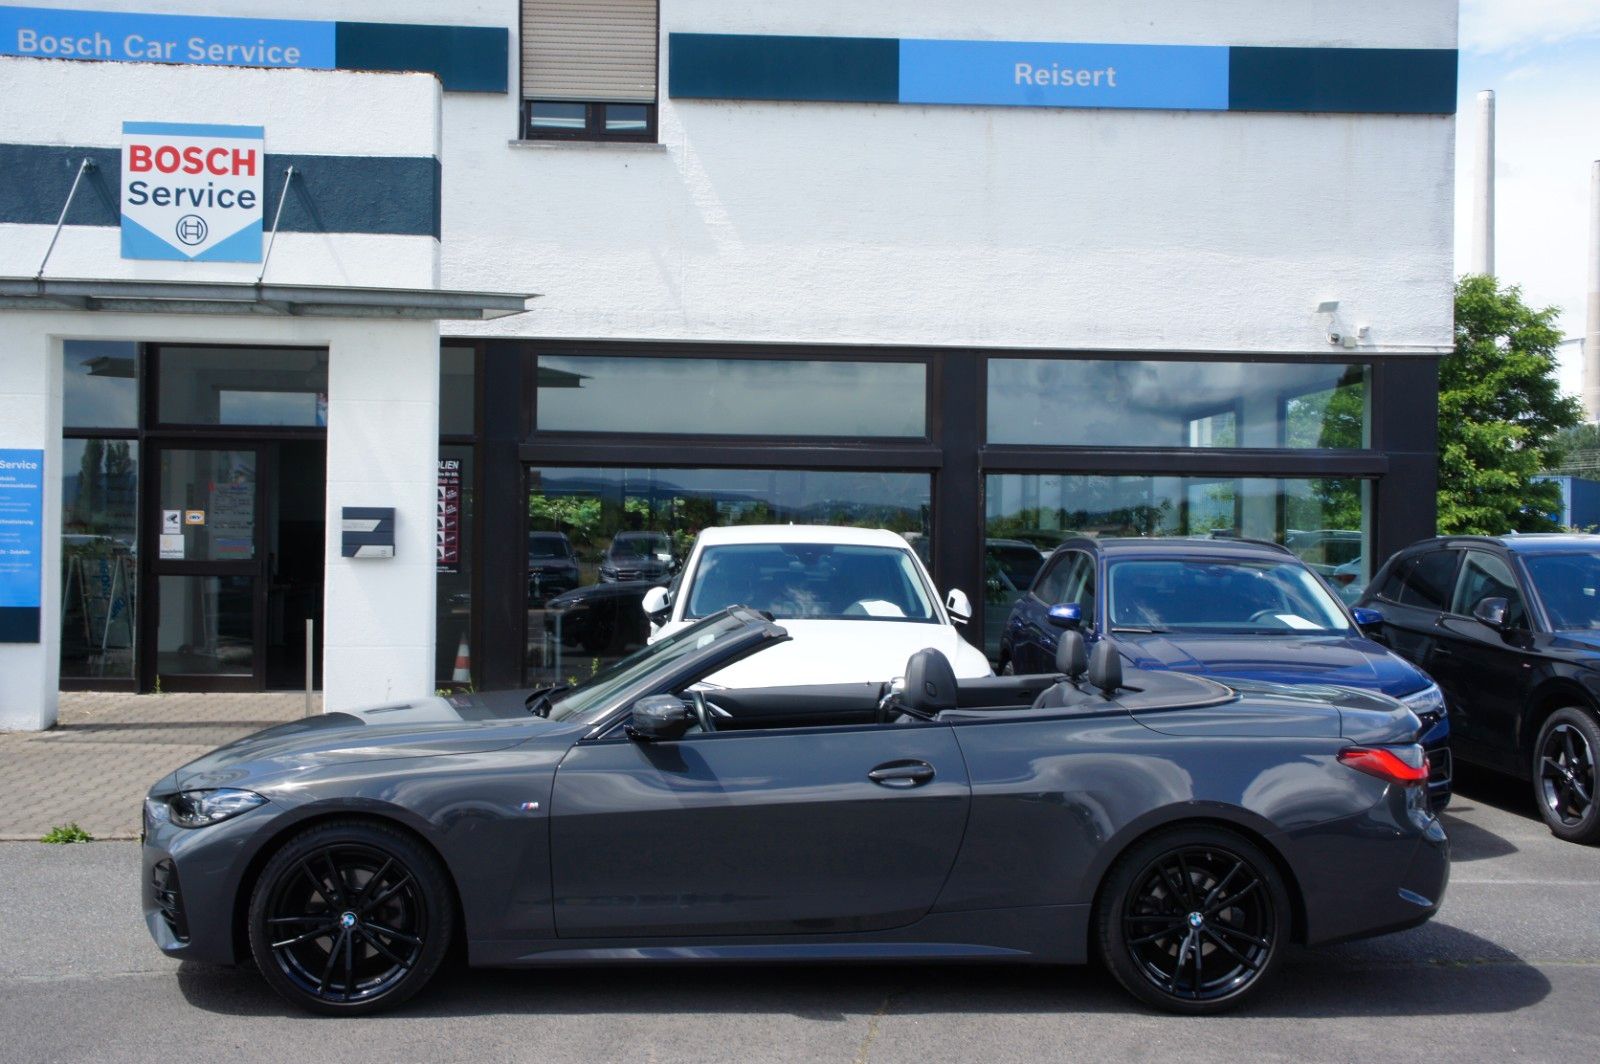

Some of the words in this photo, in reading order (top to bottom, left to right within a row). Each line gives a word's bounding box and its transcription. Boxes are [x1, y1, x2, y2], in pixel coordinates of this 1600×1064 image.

[17, 29, 111, 56] Bosch
[123, 34, 177, 59] Car
[187, 37, 300, 64] Service
[1014, 62, 1118, 88] Reisert
[129, 144, 256, 177] BOSCH
[128, 180, 256, 210] Service
[0, 460, 38, 470] Service
